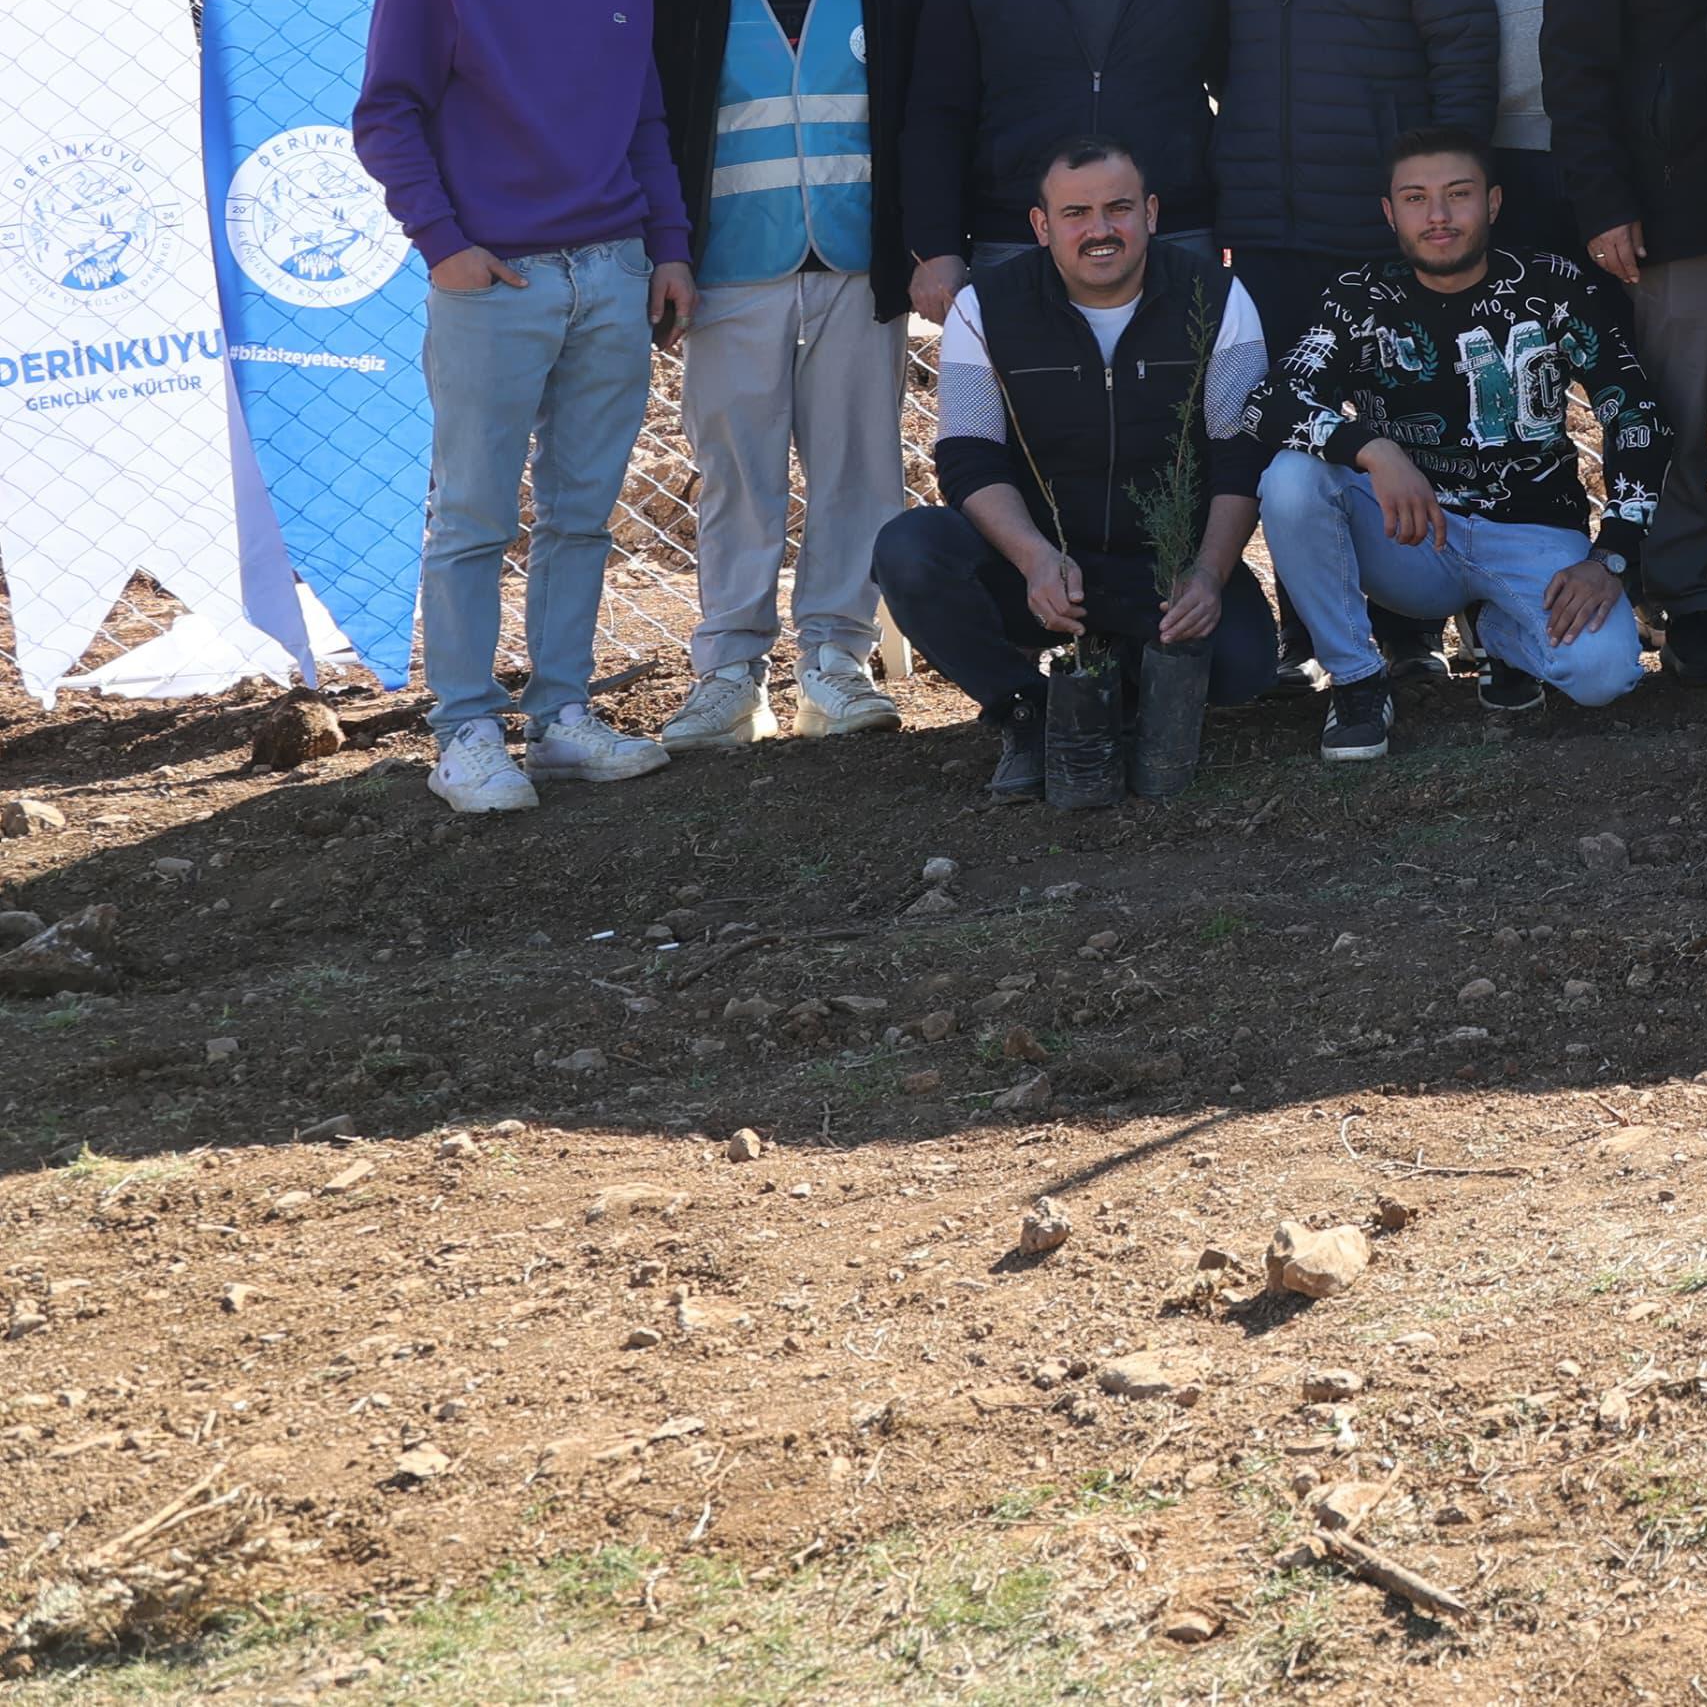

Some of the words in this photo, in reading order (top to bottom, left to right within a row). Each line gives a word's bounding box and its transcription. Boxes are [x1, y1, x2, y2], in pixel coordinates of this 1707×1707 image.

[13, 142, 146, 190] DERİNKUYU
[258, 133, 346, 167] DERİNK
[232, 205, 247, 214] 20
[0, 328, 225, 387] DERİNKUYU
[229, 345, 386, 372] #bizbizeyeteceğiz
[26, 386, 103, 412] GENÇLİK
[108, 387, 129, 401] ve
[133, 375, 202, 397] KÜLTÜR
